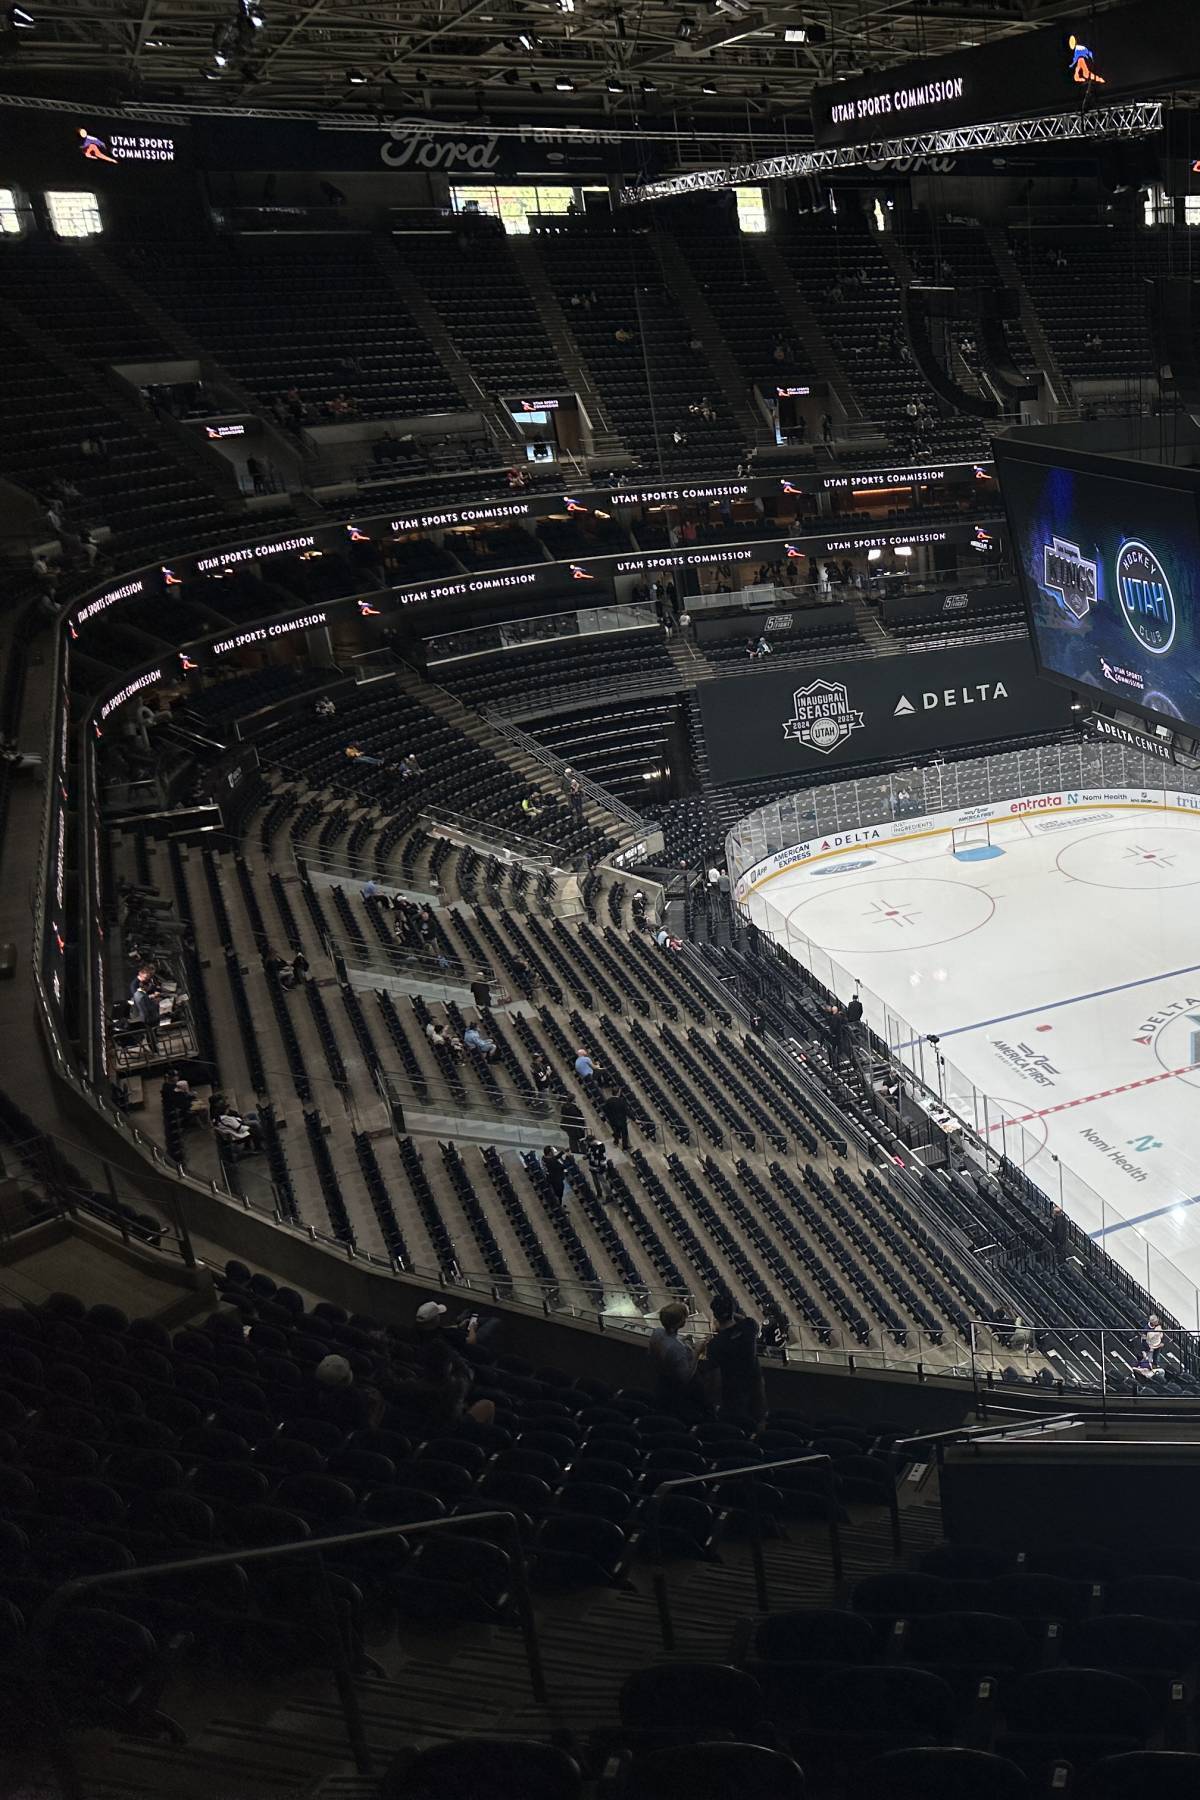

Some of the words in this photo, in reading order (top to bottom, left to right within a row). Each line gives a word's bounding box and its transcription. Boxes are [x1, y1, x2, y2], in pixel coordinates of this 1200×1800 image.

[832, 101, 855, 123] UTAH
[857, 95, 891, 120] SPORTS
[894, 77, 963, 111] COMMISSION
[111, 136, 137, 147] UTAH
[139, 138, 174, 150] SPORTS
[380, 117, 499, 168] Ford
[112, 148, 174, 160] COMMISSION
[824, 477, 848, 487] UTAH
[851, 474, 885, 486] SPORTS
[887, 471, 944, 482] COMMISSION
[612, 494, 639, 504] UTAH
[642, 490, 679, 502] SPORTS
[683, 485, 747, 498] COMMISSION
[392, 518, 419, 531] UTAH
[422, 512, 460, 527] SPORTS
[461, 504, 528, 522] COMMISSION
[827, 541, 851, 551] UTAH
[854, 537, 887, 549] SPORTS
[889, 532, 946, 546] COMMISSION
[199, 558, 219, 571] UTAH
[221, 550, 253, 567] SPORTS
[255, 536, 314, 557] COMMISSION
[617, 560, 644, 571] UTAH
[647, 556, 684, 569] SPORTS
[687, 550, 751, 565] COMMISSION
[1123, 550, 1157, 575] HOCKEY
[401, 591, 428, 604] UTAH
[431, 584, 467, 599] SPORTS
[469, 574, 536, 592] COMMISSION
[1122, 577, 1168, 623] UTAH
[214, 640, 234, 654] UTAH
[236, 630, 267, 647] SPORTS
[269, 613, 326, 636] COMMISSION
[1139, 625, 1162, 642] CLUB
[797, 692, 845, 707] INAUGURAL
[923, 682, 1009, 710] DELTA
[799, 702, 846, 720] SEASON
[837, 714, 854, 723] 2025
[815, 727, 835, 738] UTAH
[1105, 723, 1134, 744] DELTA
[1135, 736, 1170, 759] CENTER
[1010, 795, 1062, 813] entrata
[834, 830, 880, 847] DELTA
[774, 844, 810, 863] AMERICAN
[778, 851, 812, 869] EXPRESS
[991, 1040, 1030, 1069] AMERICA
[1024, 1067, 1056, 1087] FIRST
[1080, 1128, 1112, 1156] Nomi
[1108, 1151, 1148, 1182] Health
